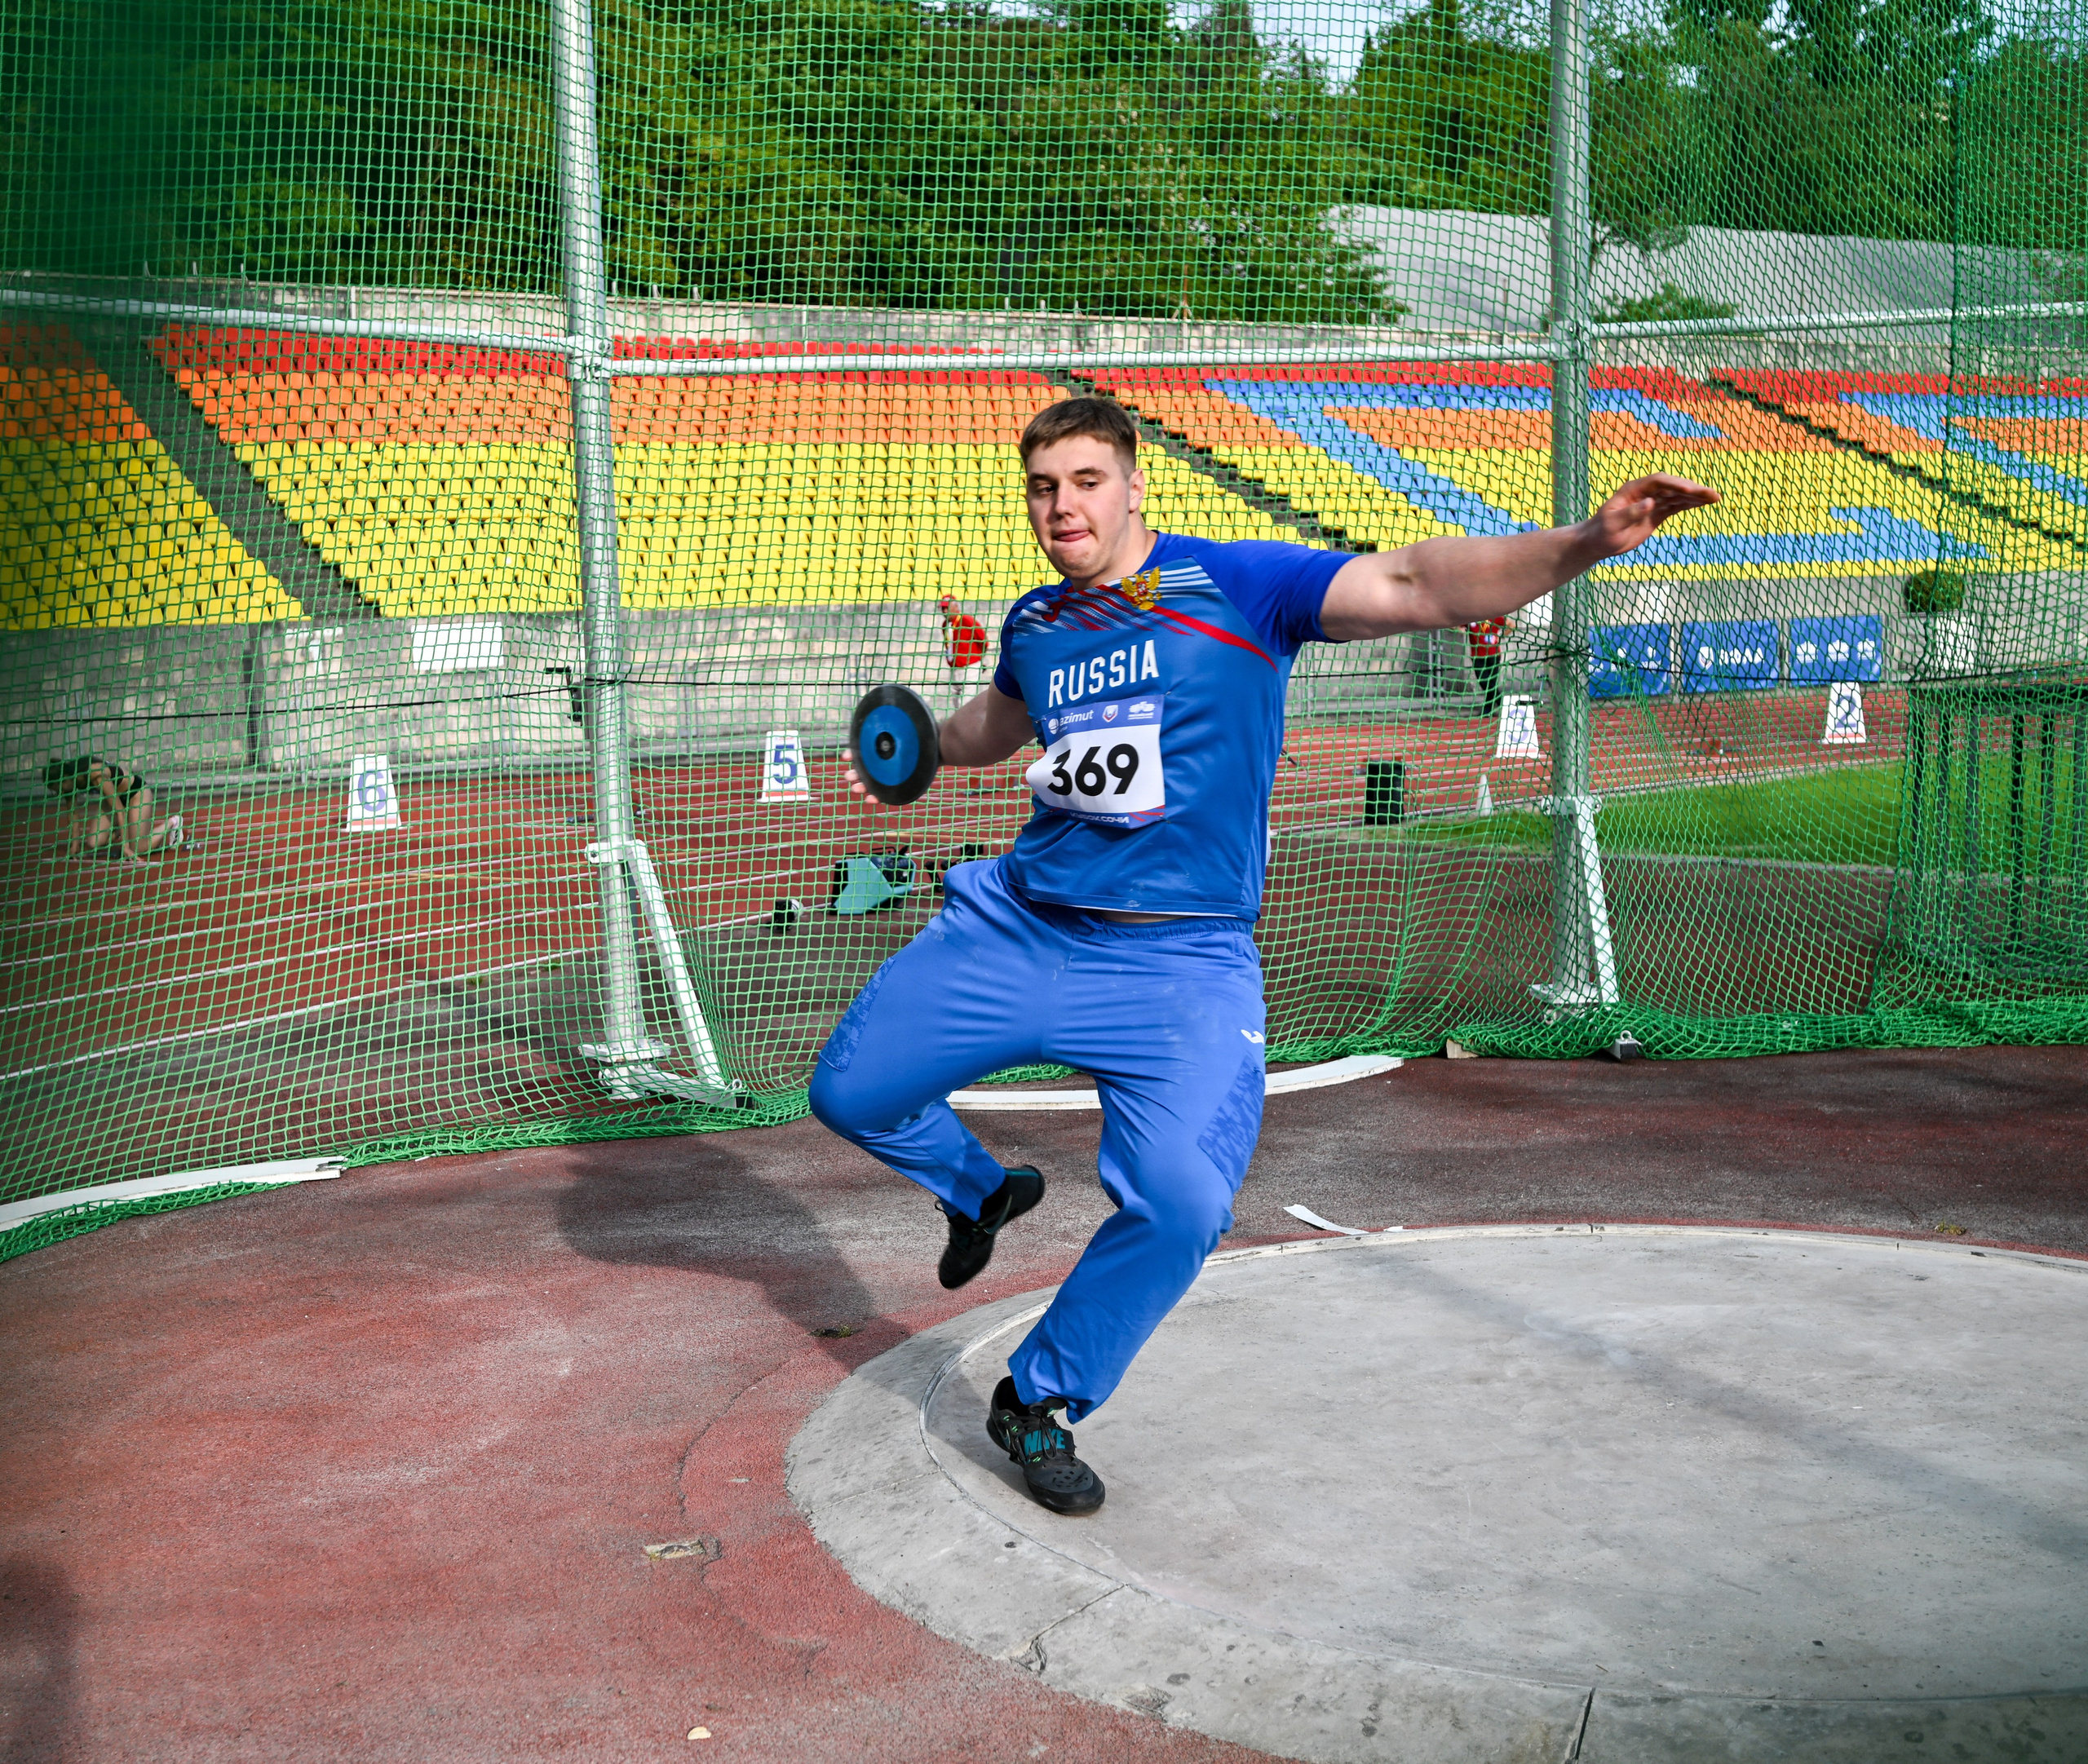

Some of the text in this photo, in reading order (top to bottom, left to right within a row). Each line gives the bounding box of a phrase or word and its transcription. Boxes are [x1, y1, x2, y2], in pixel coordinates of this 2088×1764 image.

[1048, 639, 1160, 708] RUSSIA
[1059, 710, 1095, 726] azimut
[1507, 708, 1529, 743] 3
[1835, 695, 1857, 728] 2
[772, 744, 798, 785] 5
[1047, 743, 1139, 797] 369
[357, 768, 387, 812] 6
[1024, 1428, 1066, 1457] NIKE
